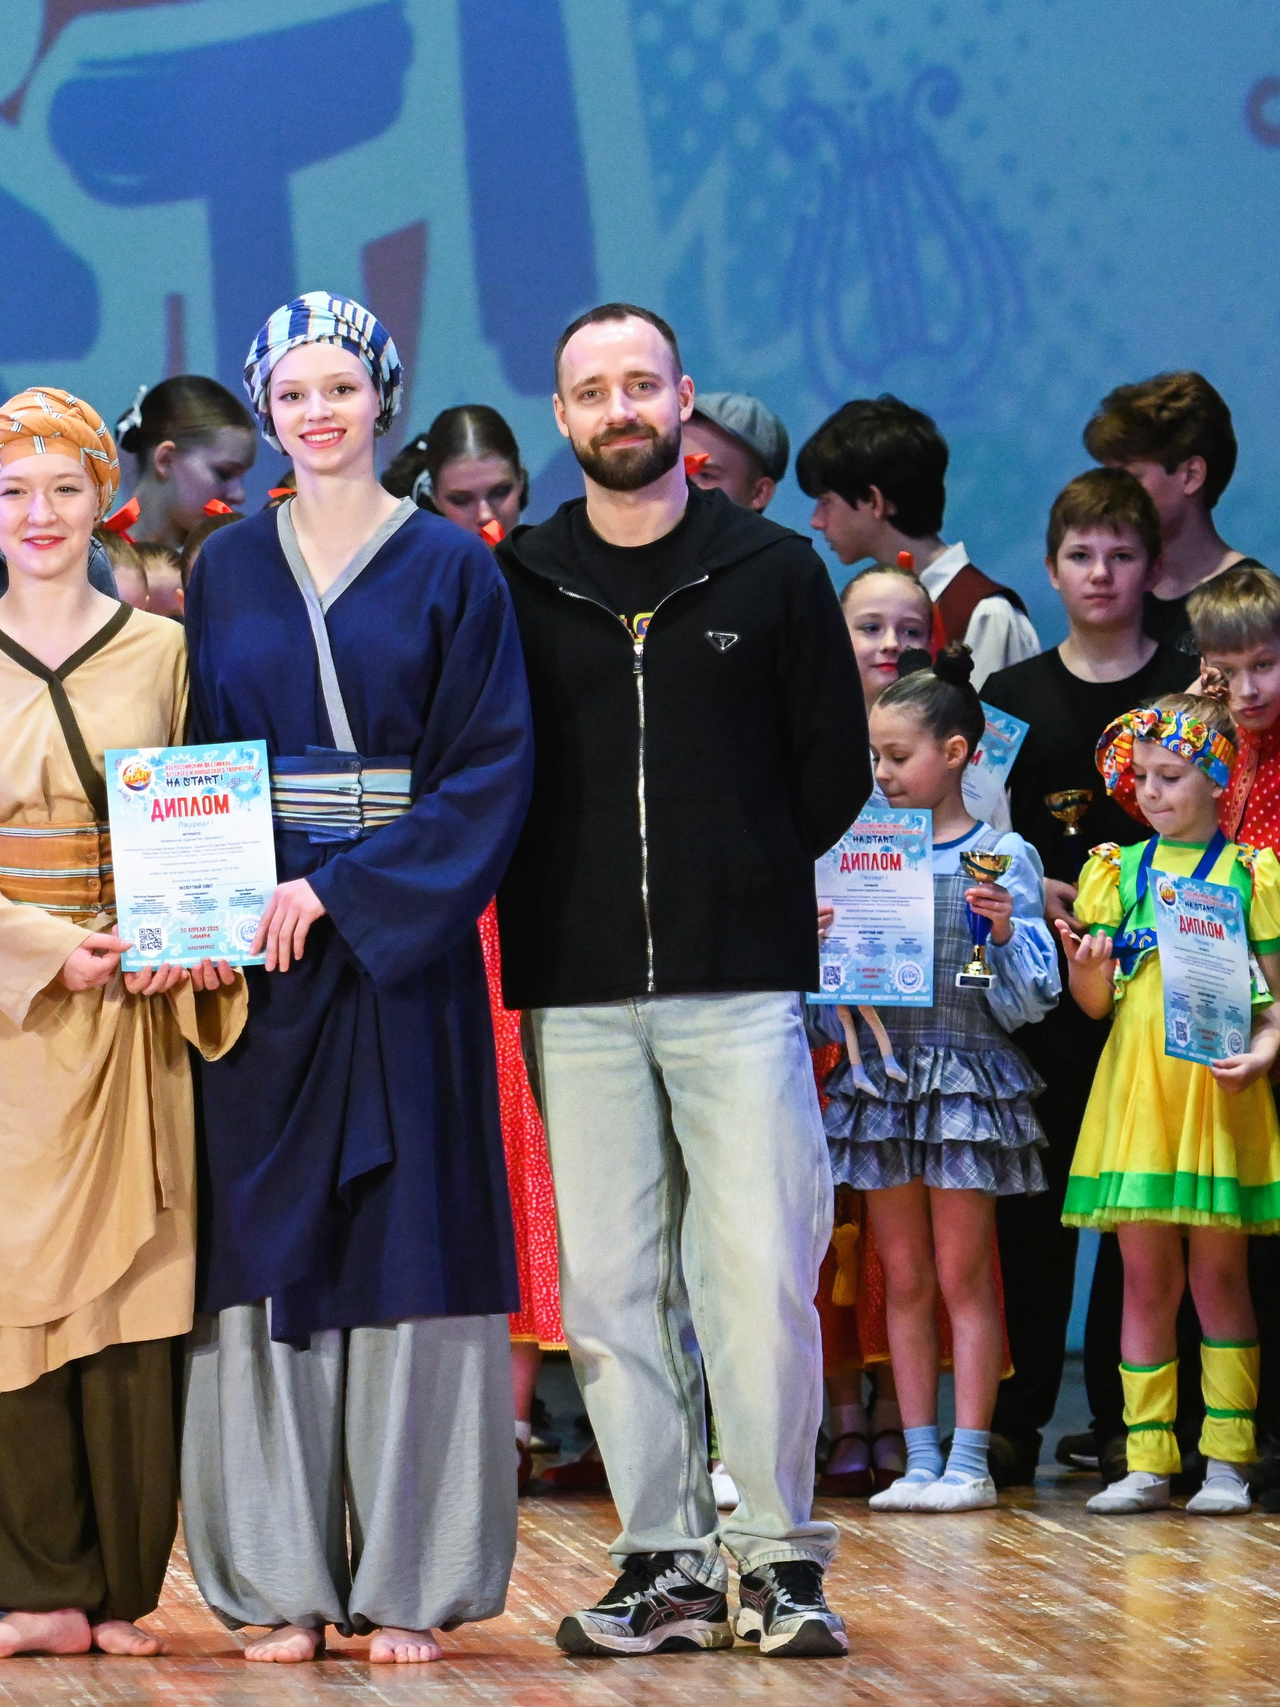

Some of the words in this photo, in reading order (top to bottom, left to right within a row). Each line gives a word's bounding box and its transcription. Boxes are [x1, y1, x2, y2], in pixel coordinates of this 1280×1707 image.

[166, 777, 181, 788] НА
[151, 794, 230, 822] ДИПЛОМ
[178, 820, 210, 829] Лауреат
[840, 853, 902, 874] ДИПЛОМ
[1179, 914, 1225, 940] ДИПЛОМ
